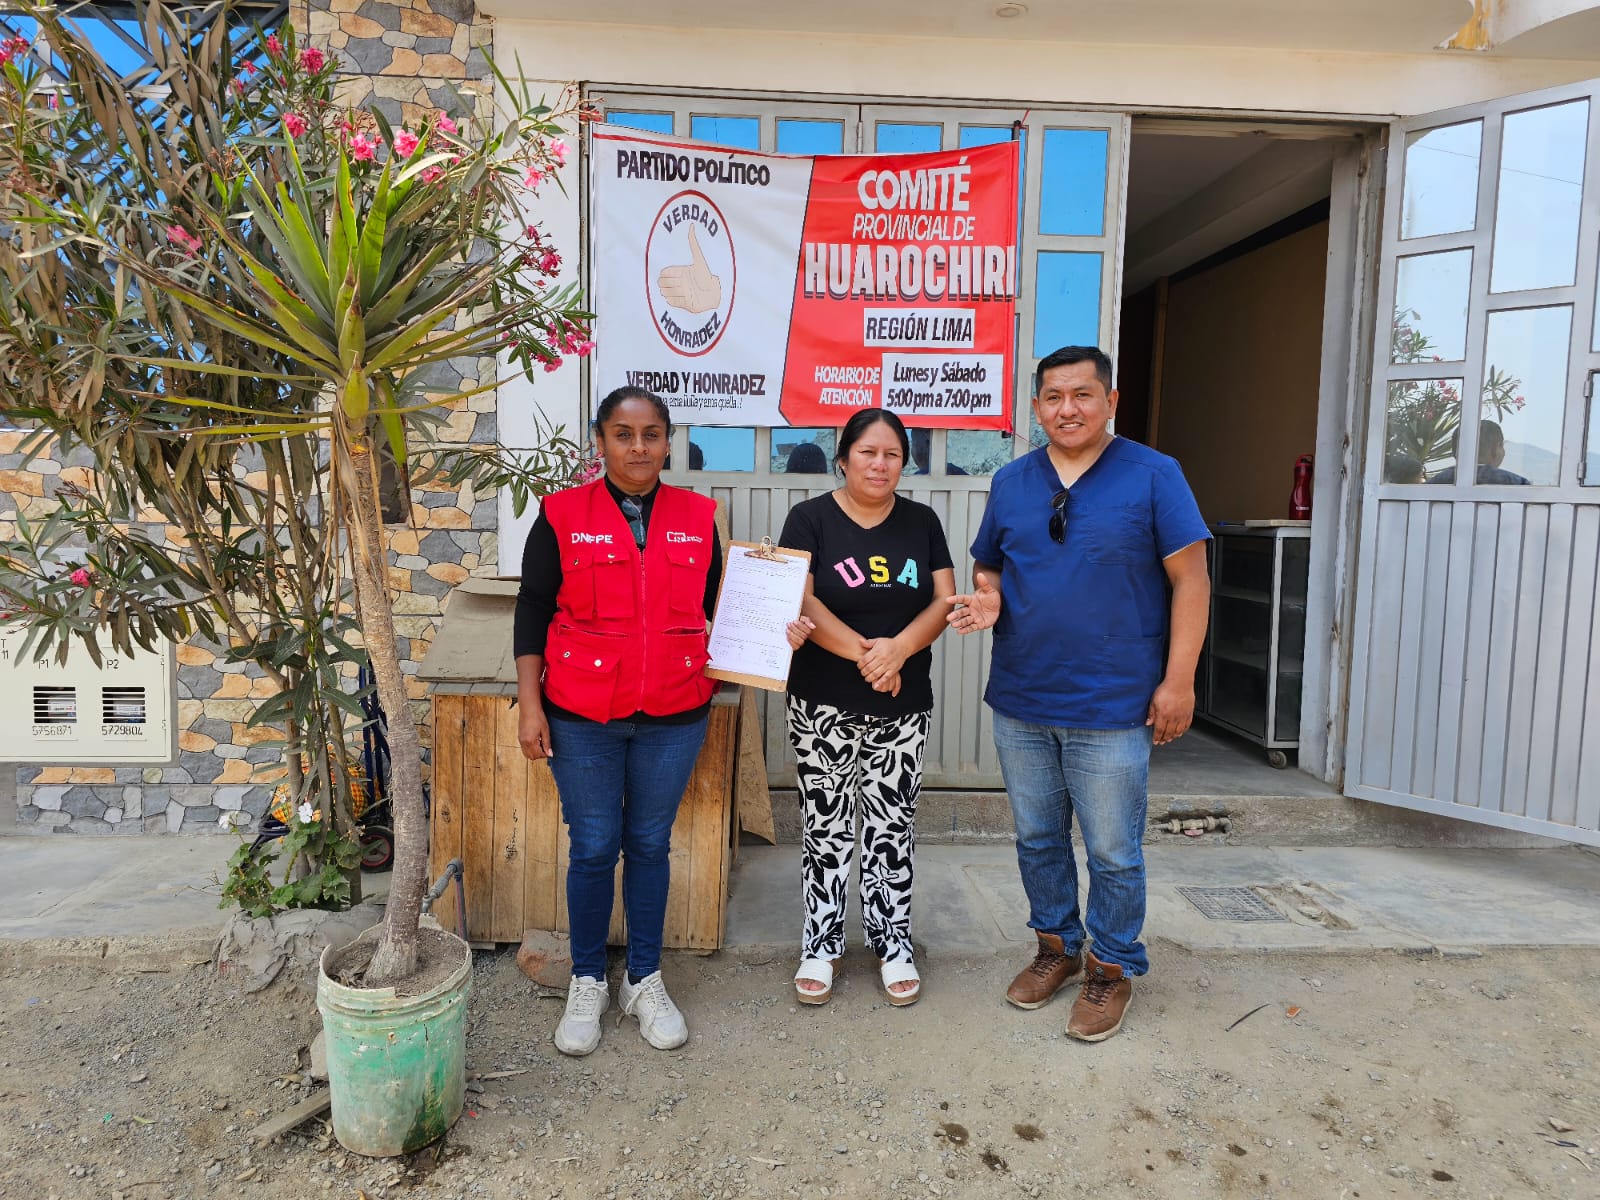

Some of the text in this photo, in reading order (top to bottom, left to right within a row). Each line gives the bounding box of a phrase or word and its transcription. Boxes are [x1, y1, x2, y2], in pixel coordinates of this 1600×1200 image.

[617, 150, 770, 186] PARTIDO POLÍTICO
[857, 156, 971, 211] COMITÉ
[663, 204, 719, 237] VERDAD
[853, 213, 976, 241] PROVINCIAL DE
[804, 243, 1016, 300] HUAROCHIRI
[660, 310, 722, 348] HONRADEZ
[866, 313, 973, 342] REGIÓN LIMA
[626, 371, 766, 396] VERDAD Y HONRADEZ
[815, 366, 881, 385] HORARIO DE
[893, 361, 986, 387] Lunes y Sábado
[819, 386, 873, 406] ATENCIÓN
[833, 556, 919, 589] USA
[106, 659, 120, 669] P2
[101, 725, 143, 736] 5729804
